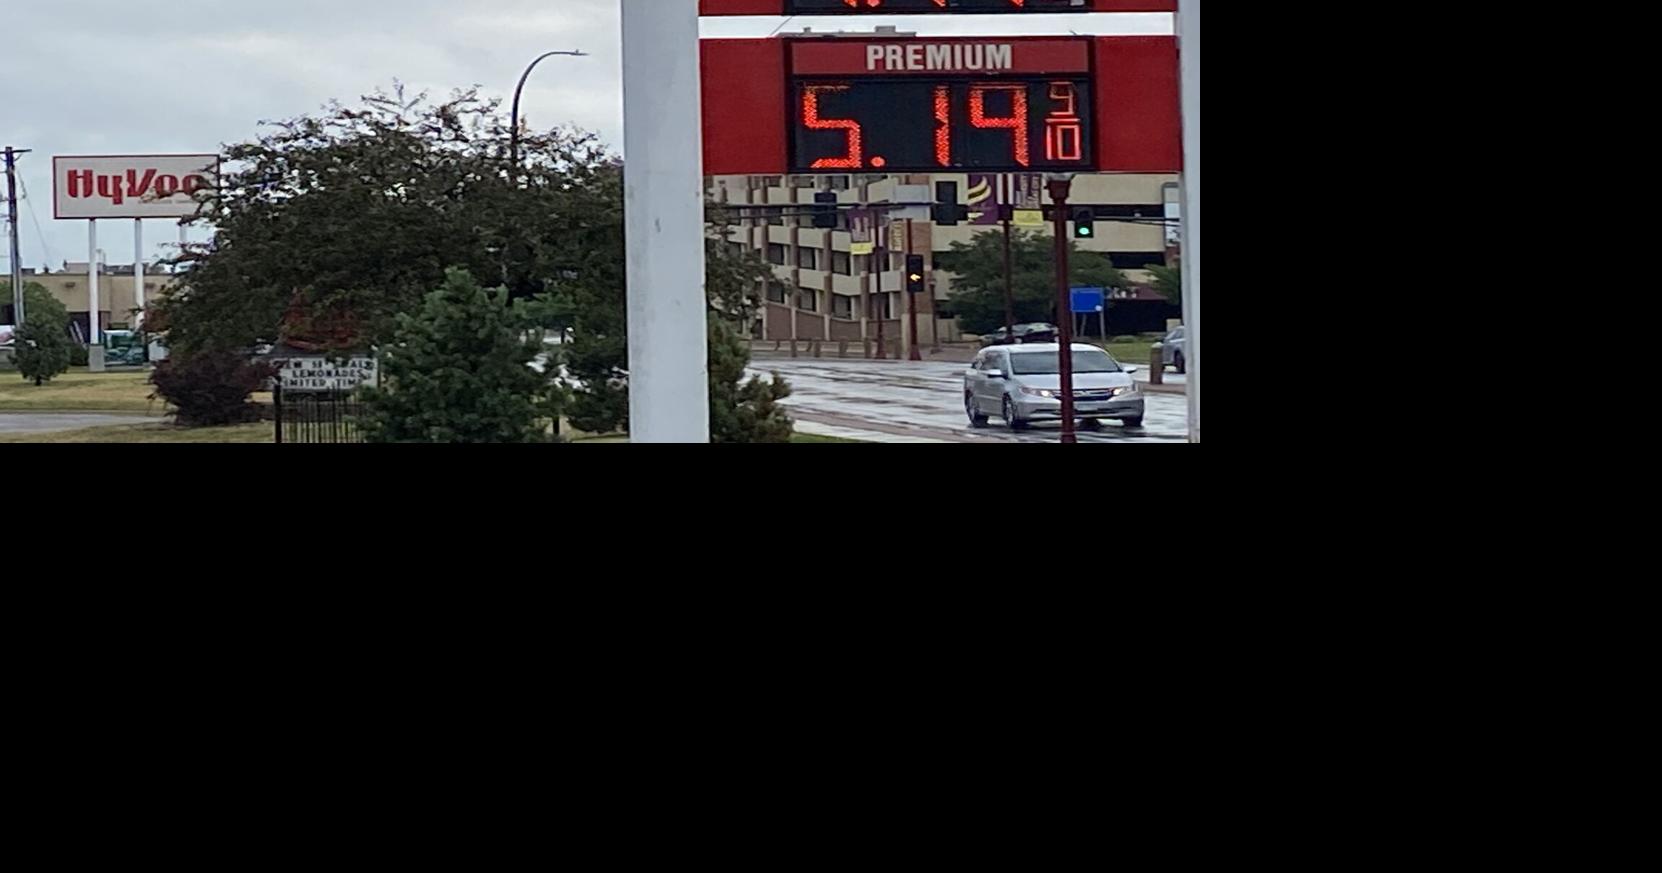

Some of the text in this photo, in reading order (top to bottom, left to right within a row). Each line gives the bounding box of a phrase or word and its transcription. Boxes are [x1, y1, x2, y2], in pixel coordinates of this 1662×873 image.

[866, 44, 1013, 71] PREMIUM
[292, 369, 364, 378] LEMONADES
[279, 379, 327, 387] IMITED
